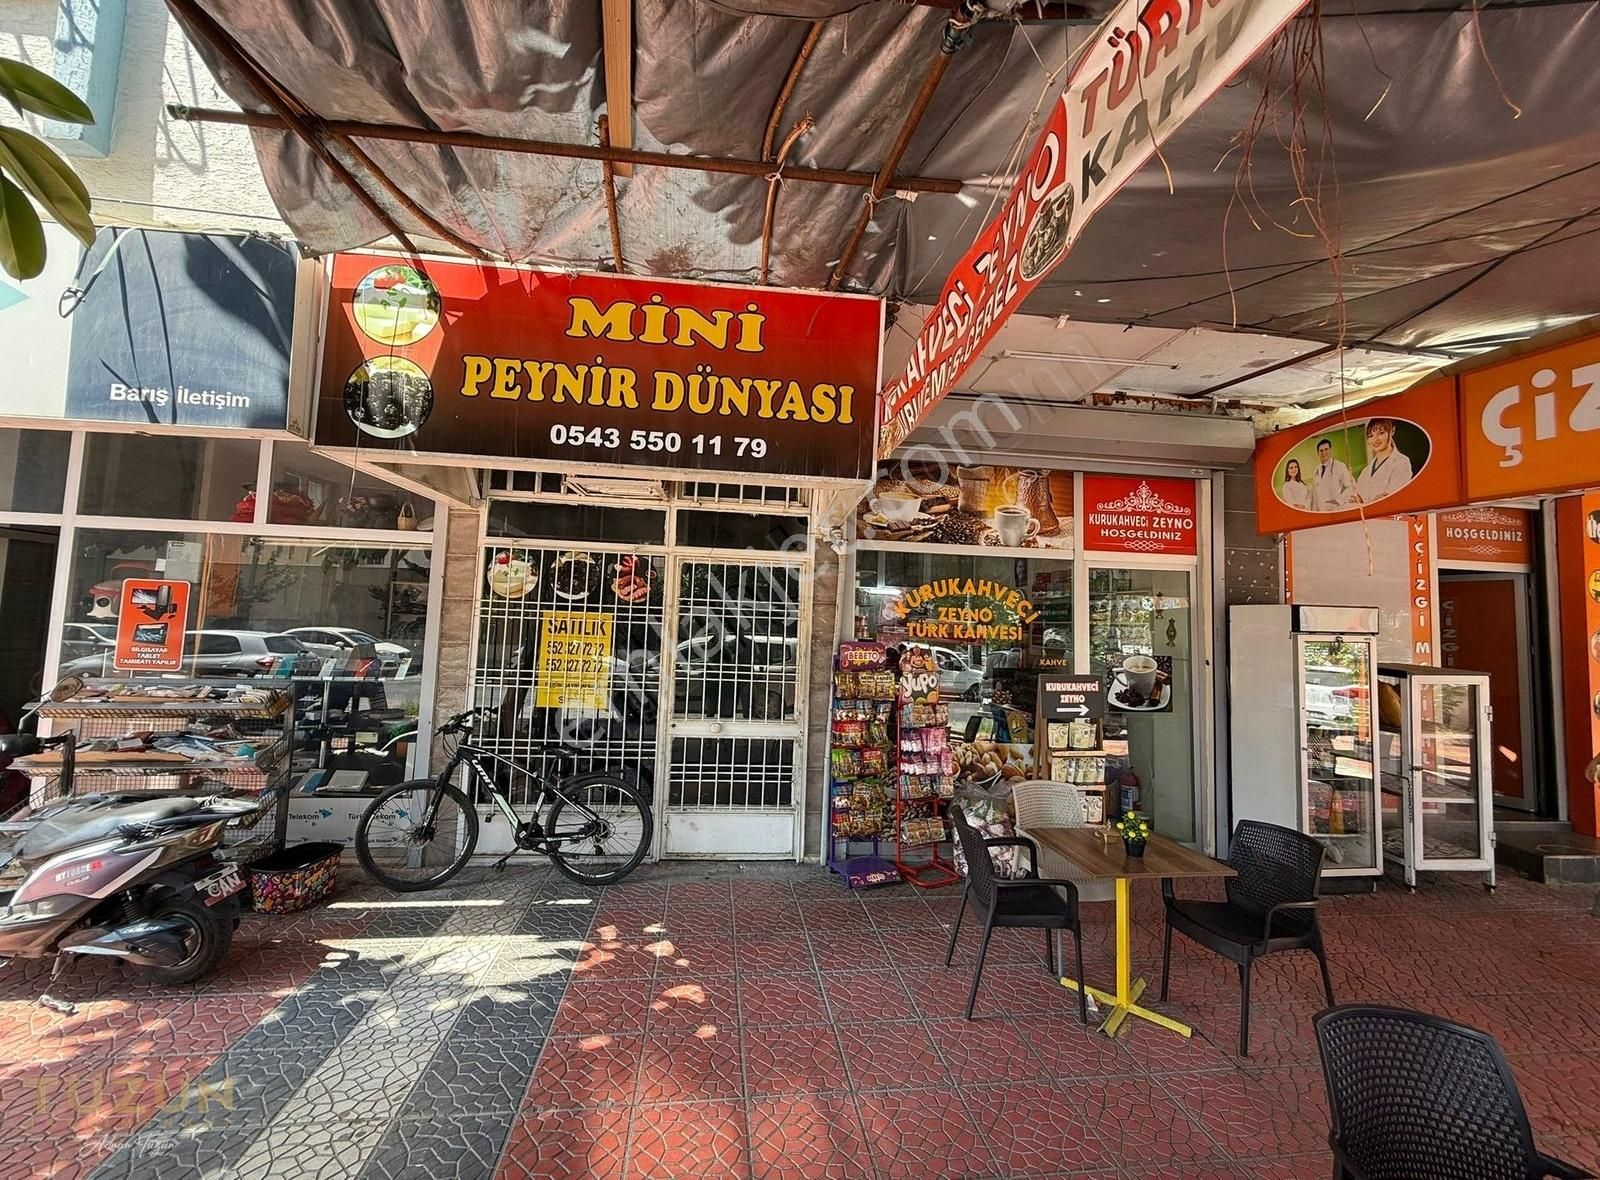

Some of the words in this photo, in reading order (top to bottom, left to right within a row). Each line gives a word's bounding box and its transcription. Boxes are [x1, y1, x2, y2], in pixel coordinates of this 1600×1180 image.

[565, 294, 766, 353] MİNİ
[110, 383, 169, 407] Barış
[177, 385, 250, 410] İletişim
[460, 355, 639, 410] PEYNİR
[651, 363, 855, 425] DÜNYASI
[550, 424, 621, 449] 0543
[629, 429, 681, 454] 550
[692, 432, 723, 456] 11
[734, 434, 768, 459] 79
[1152, 517, 1194, 530] ZEYNO
[938, 606, 993, 623] ZEYNO
[906, 619, 949, 638] TÜRK
[848, 650, 880, 661] BEBETO
[1039, 658, 1067, 666] KAHVE
[1060, 694, 1086, 704] ZEYNO
[288, 813, 320, 821] Telekom
